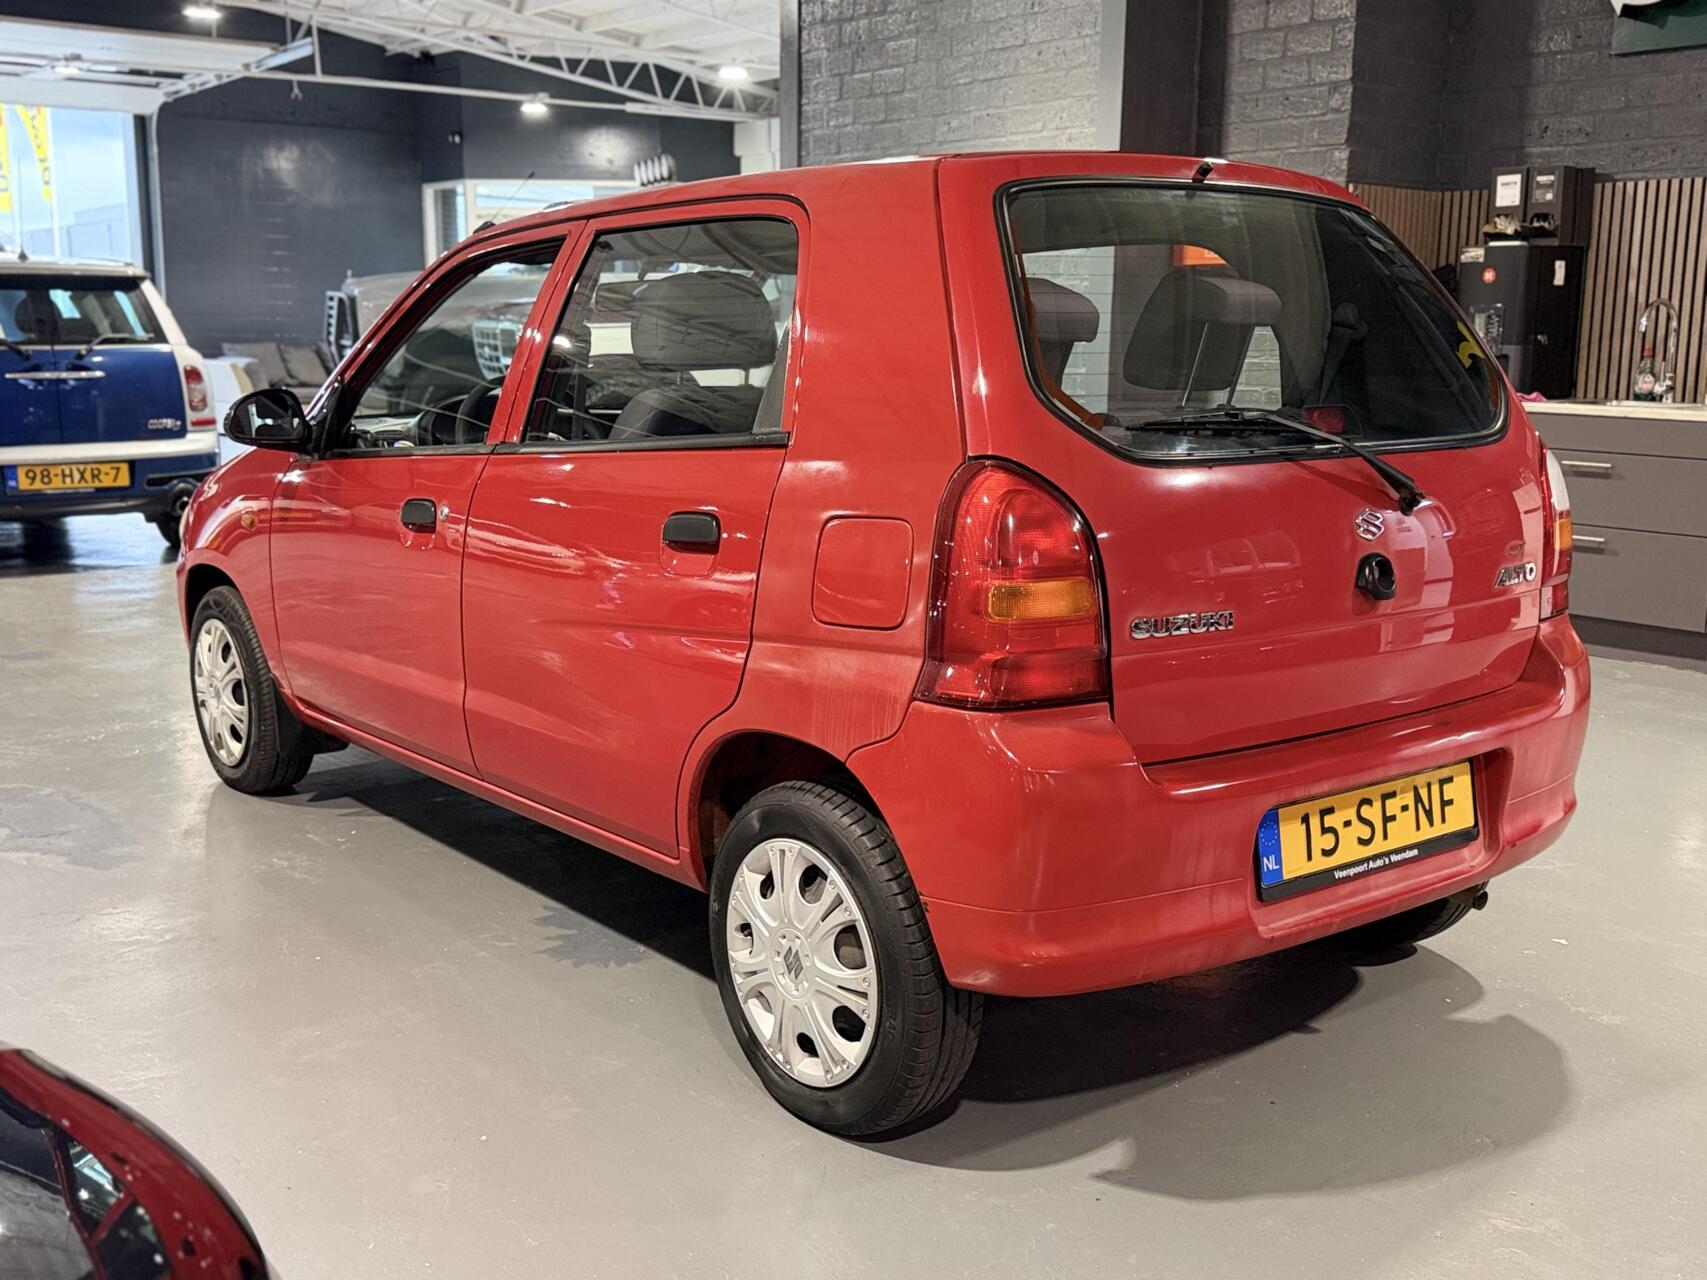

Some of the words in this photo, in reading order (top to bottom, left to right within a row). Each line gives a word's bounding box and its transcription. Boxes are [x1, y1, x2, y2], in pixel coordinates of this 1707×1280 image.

[25, 466, 122, 487] 98-HXR-7
[1494, 561, 1536, 588] ALTO
[1131, 611, 1234, 639] SUZUKI
[1301, 775, 1454, 862] 15-SF-NF
[1263, 856, 1280, 872] NL
[1334, 861, 1368, 879] Veenpoort
[1369, 856, 1389, 870] Auto's
[1390, 848, 1419, 863] Veendam
